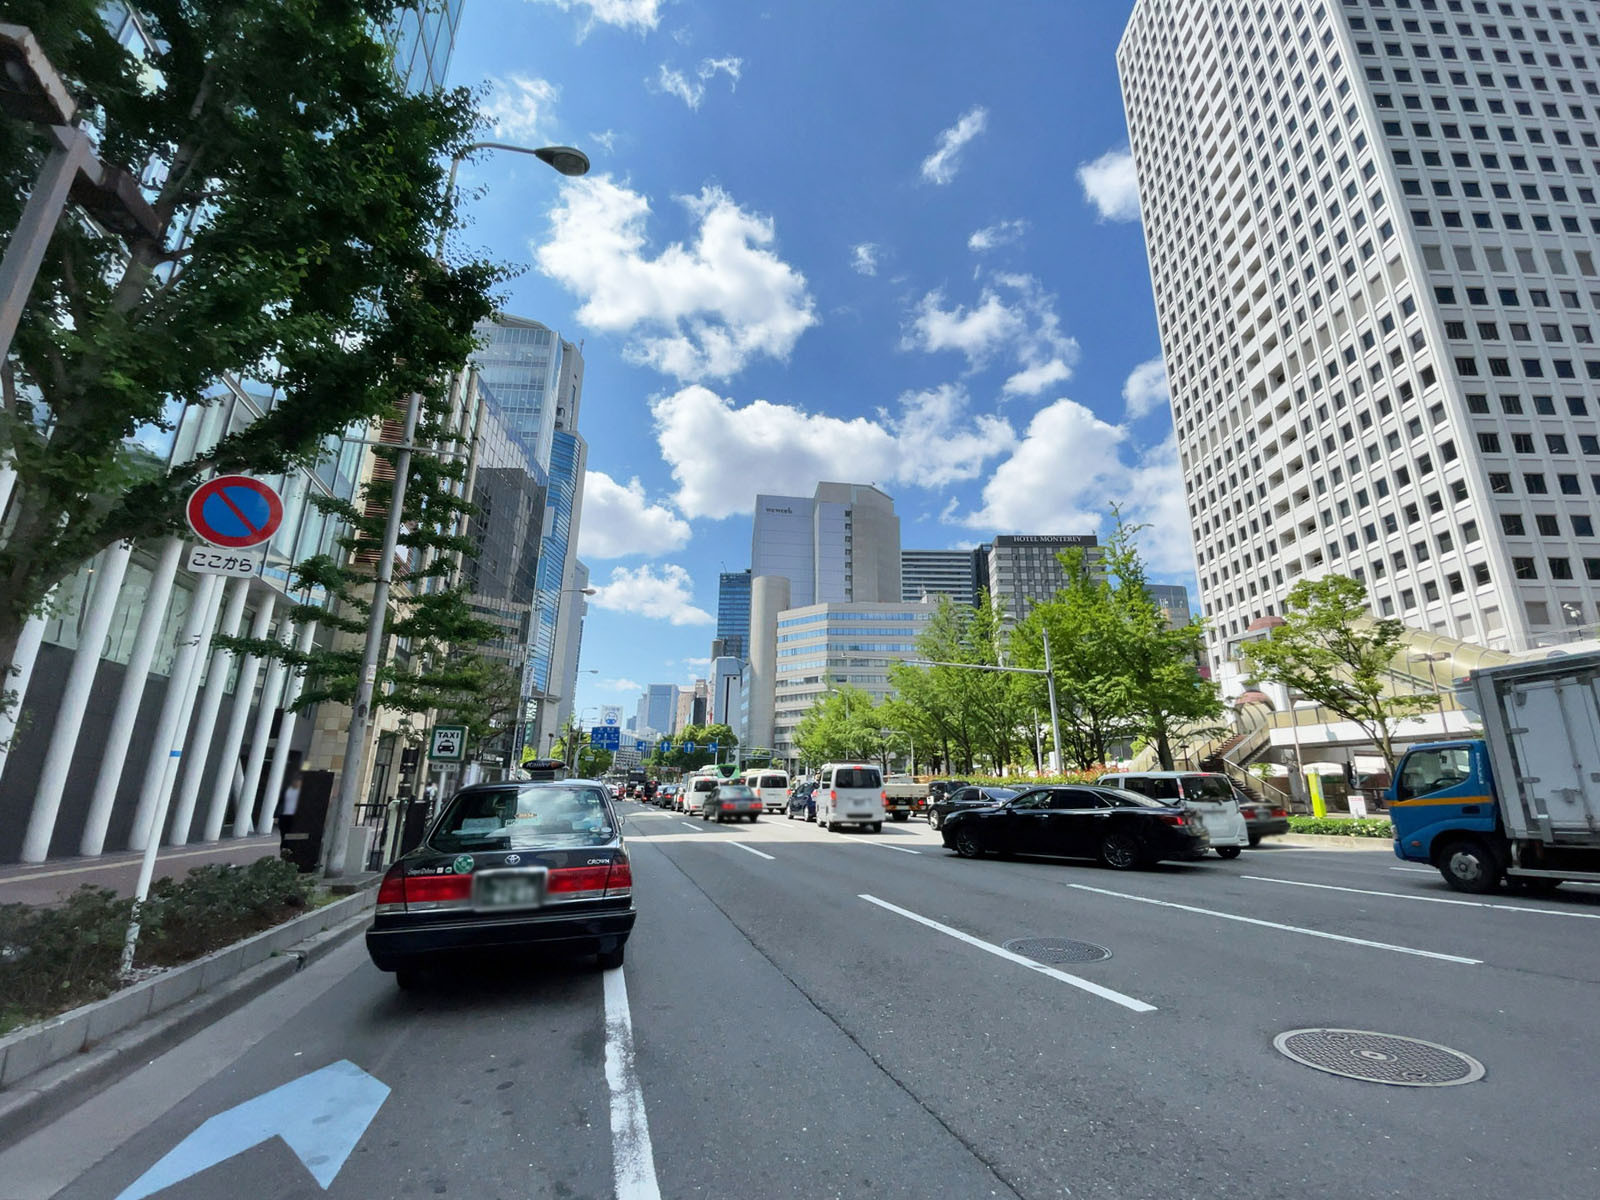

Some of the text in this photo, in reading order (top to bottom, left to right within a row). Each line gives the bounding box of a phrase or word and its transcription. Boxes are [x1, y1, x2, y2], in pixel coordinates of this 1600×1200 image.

[1013, 535, 1081, 543] HOTEL MONTEREY
[192, 552, 253, 573] ここから
[437, 731, 460, 739] TAXI
